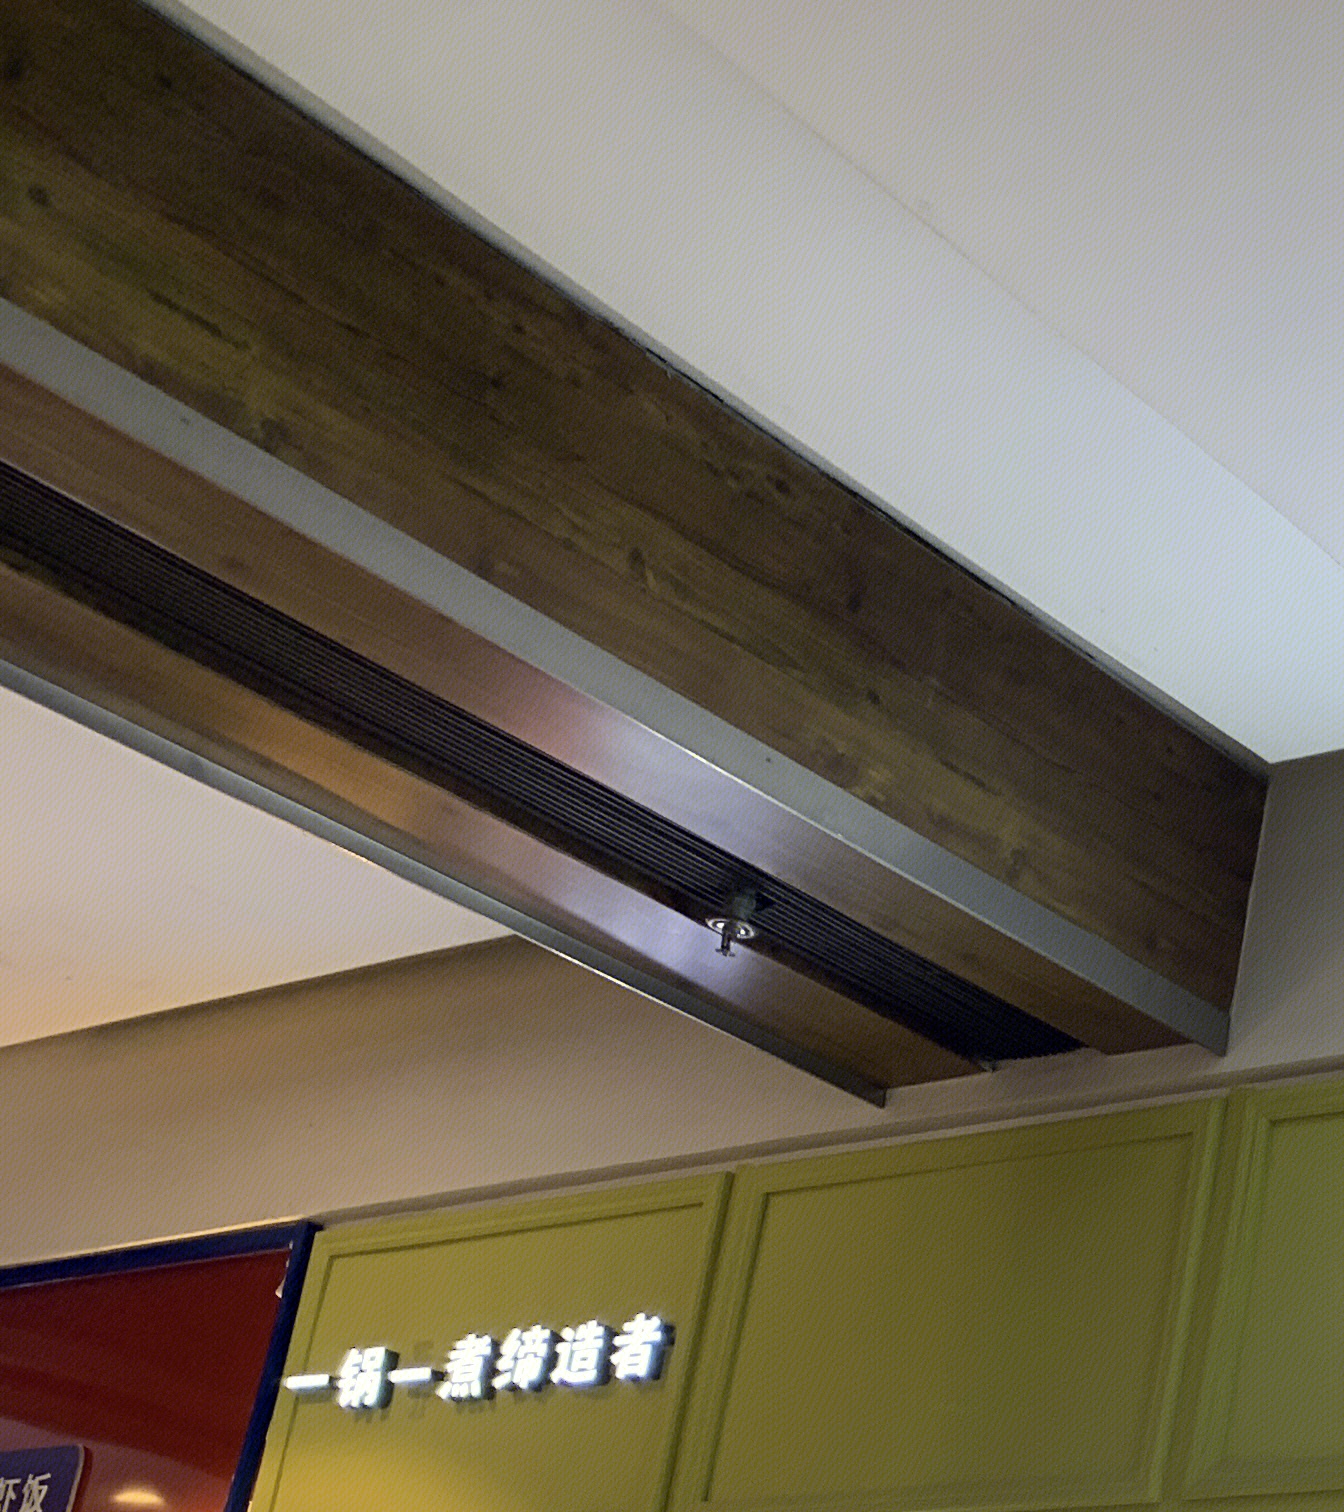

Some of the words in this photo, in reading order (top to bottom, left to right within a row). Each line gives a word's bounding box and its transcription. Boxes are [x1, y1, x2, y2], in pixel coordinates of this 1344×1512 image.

[284, 1313, 672, 1411] 一锅一煮缔造者
